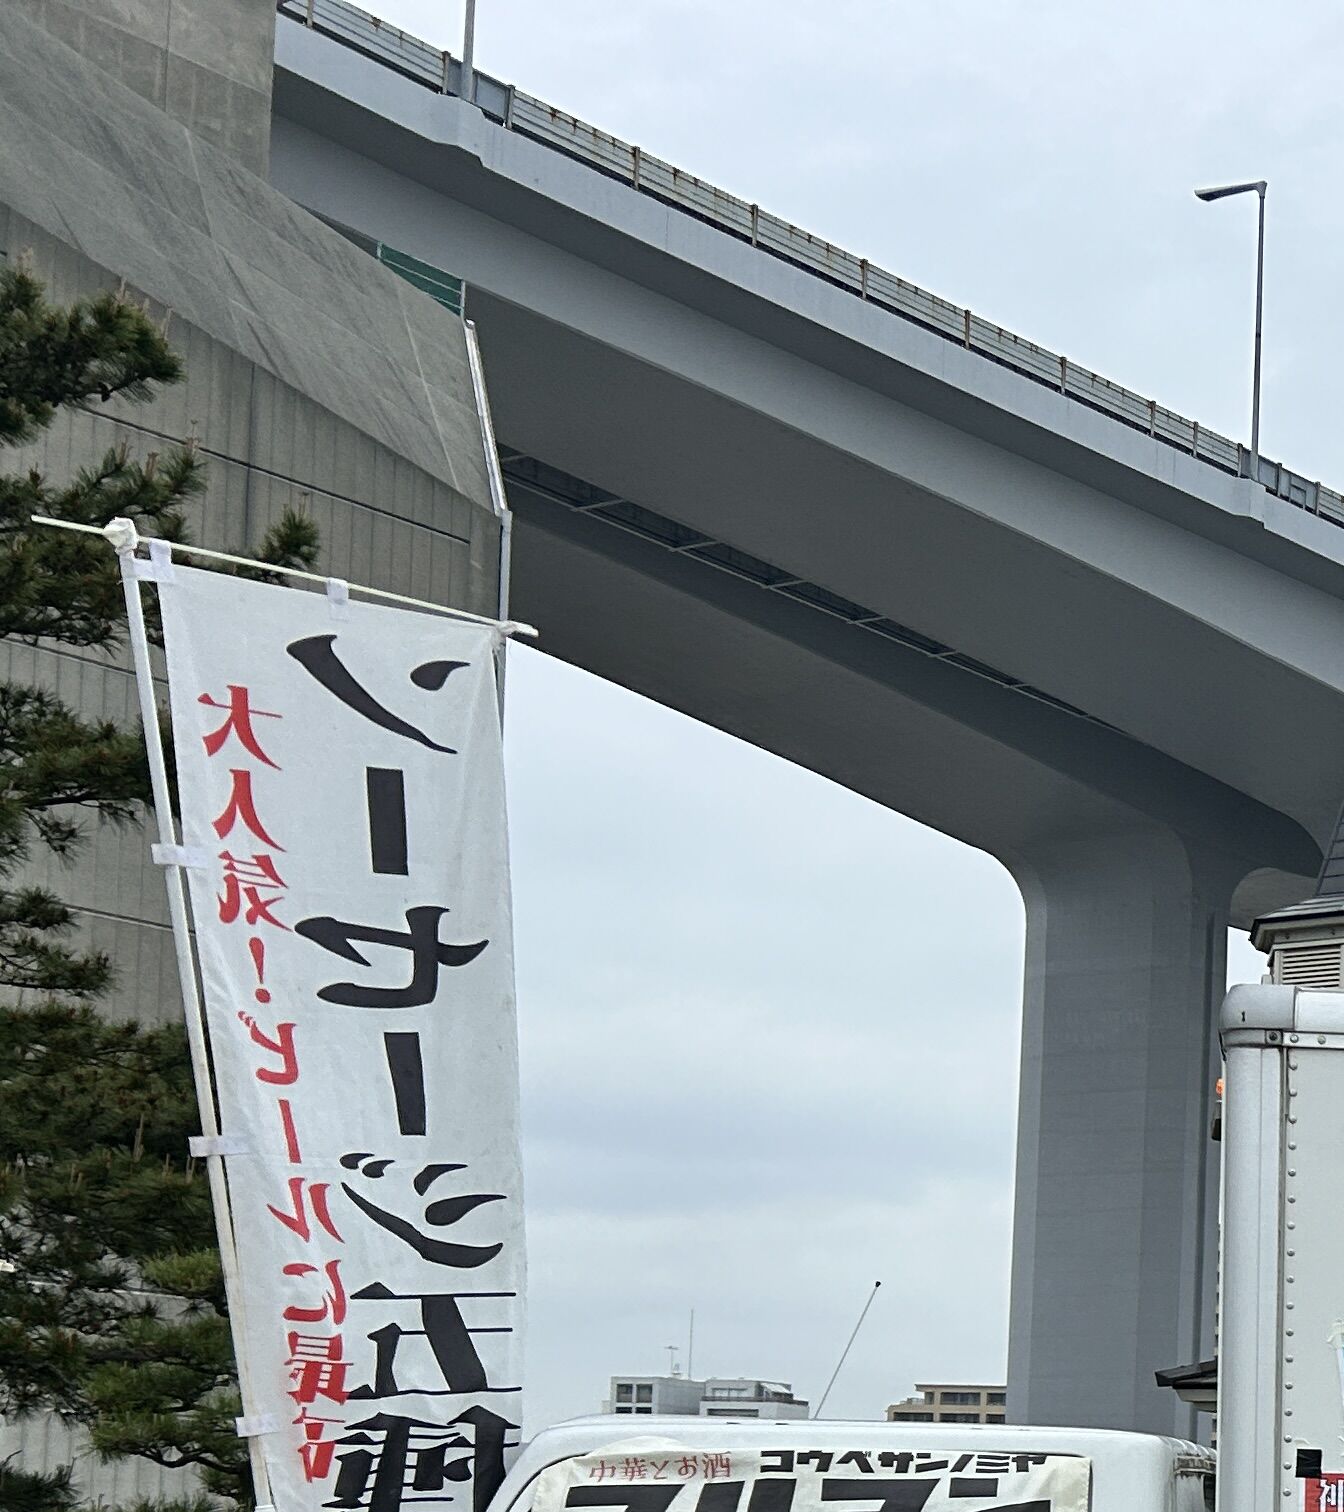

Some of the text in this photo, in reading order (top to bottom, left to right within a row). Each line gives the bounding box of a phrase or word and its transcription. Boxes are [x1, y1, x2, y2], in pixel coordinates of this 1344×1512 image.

[589, 1452, 731, 1481] 中華とお酒
[760, 1450, 1047, 1474] コウベサンノミヤ
